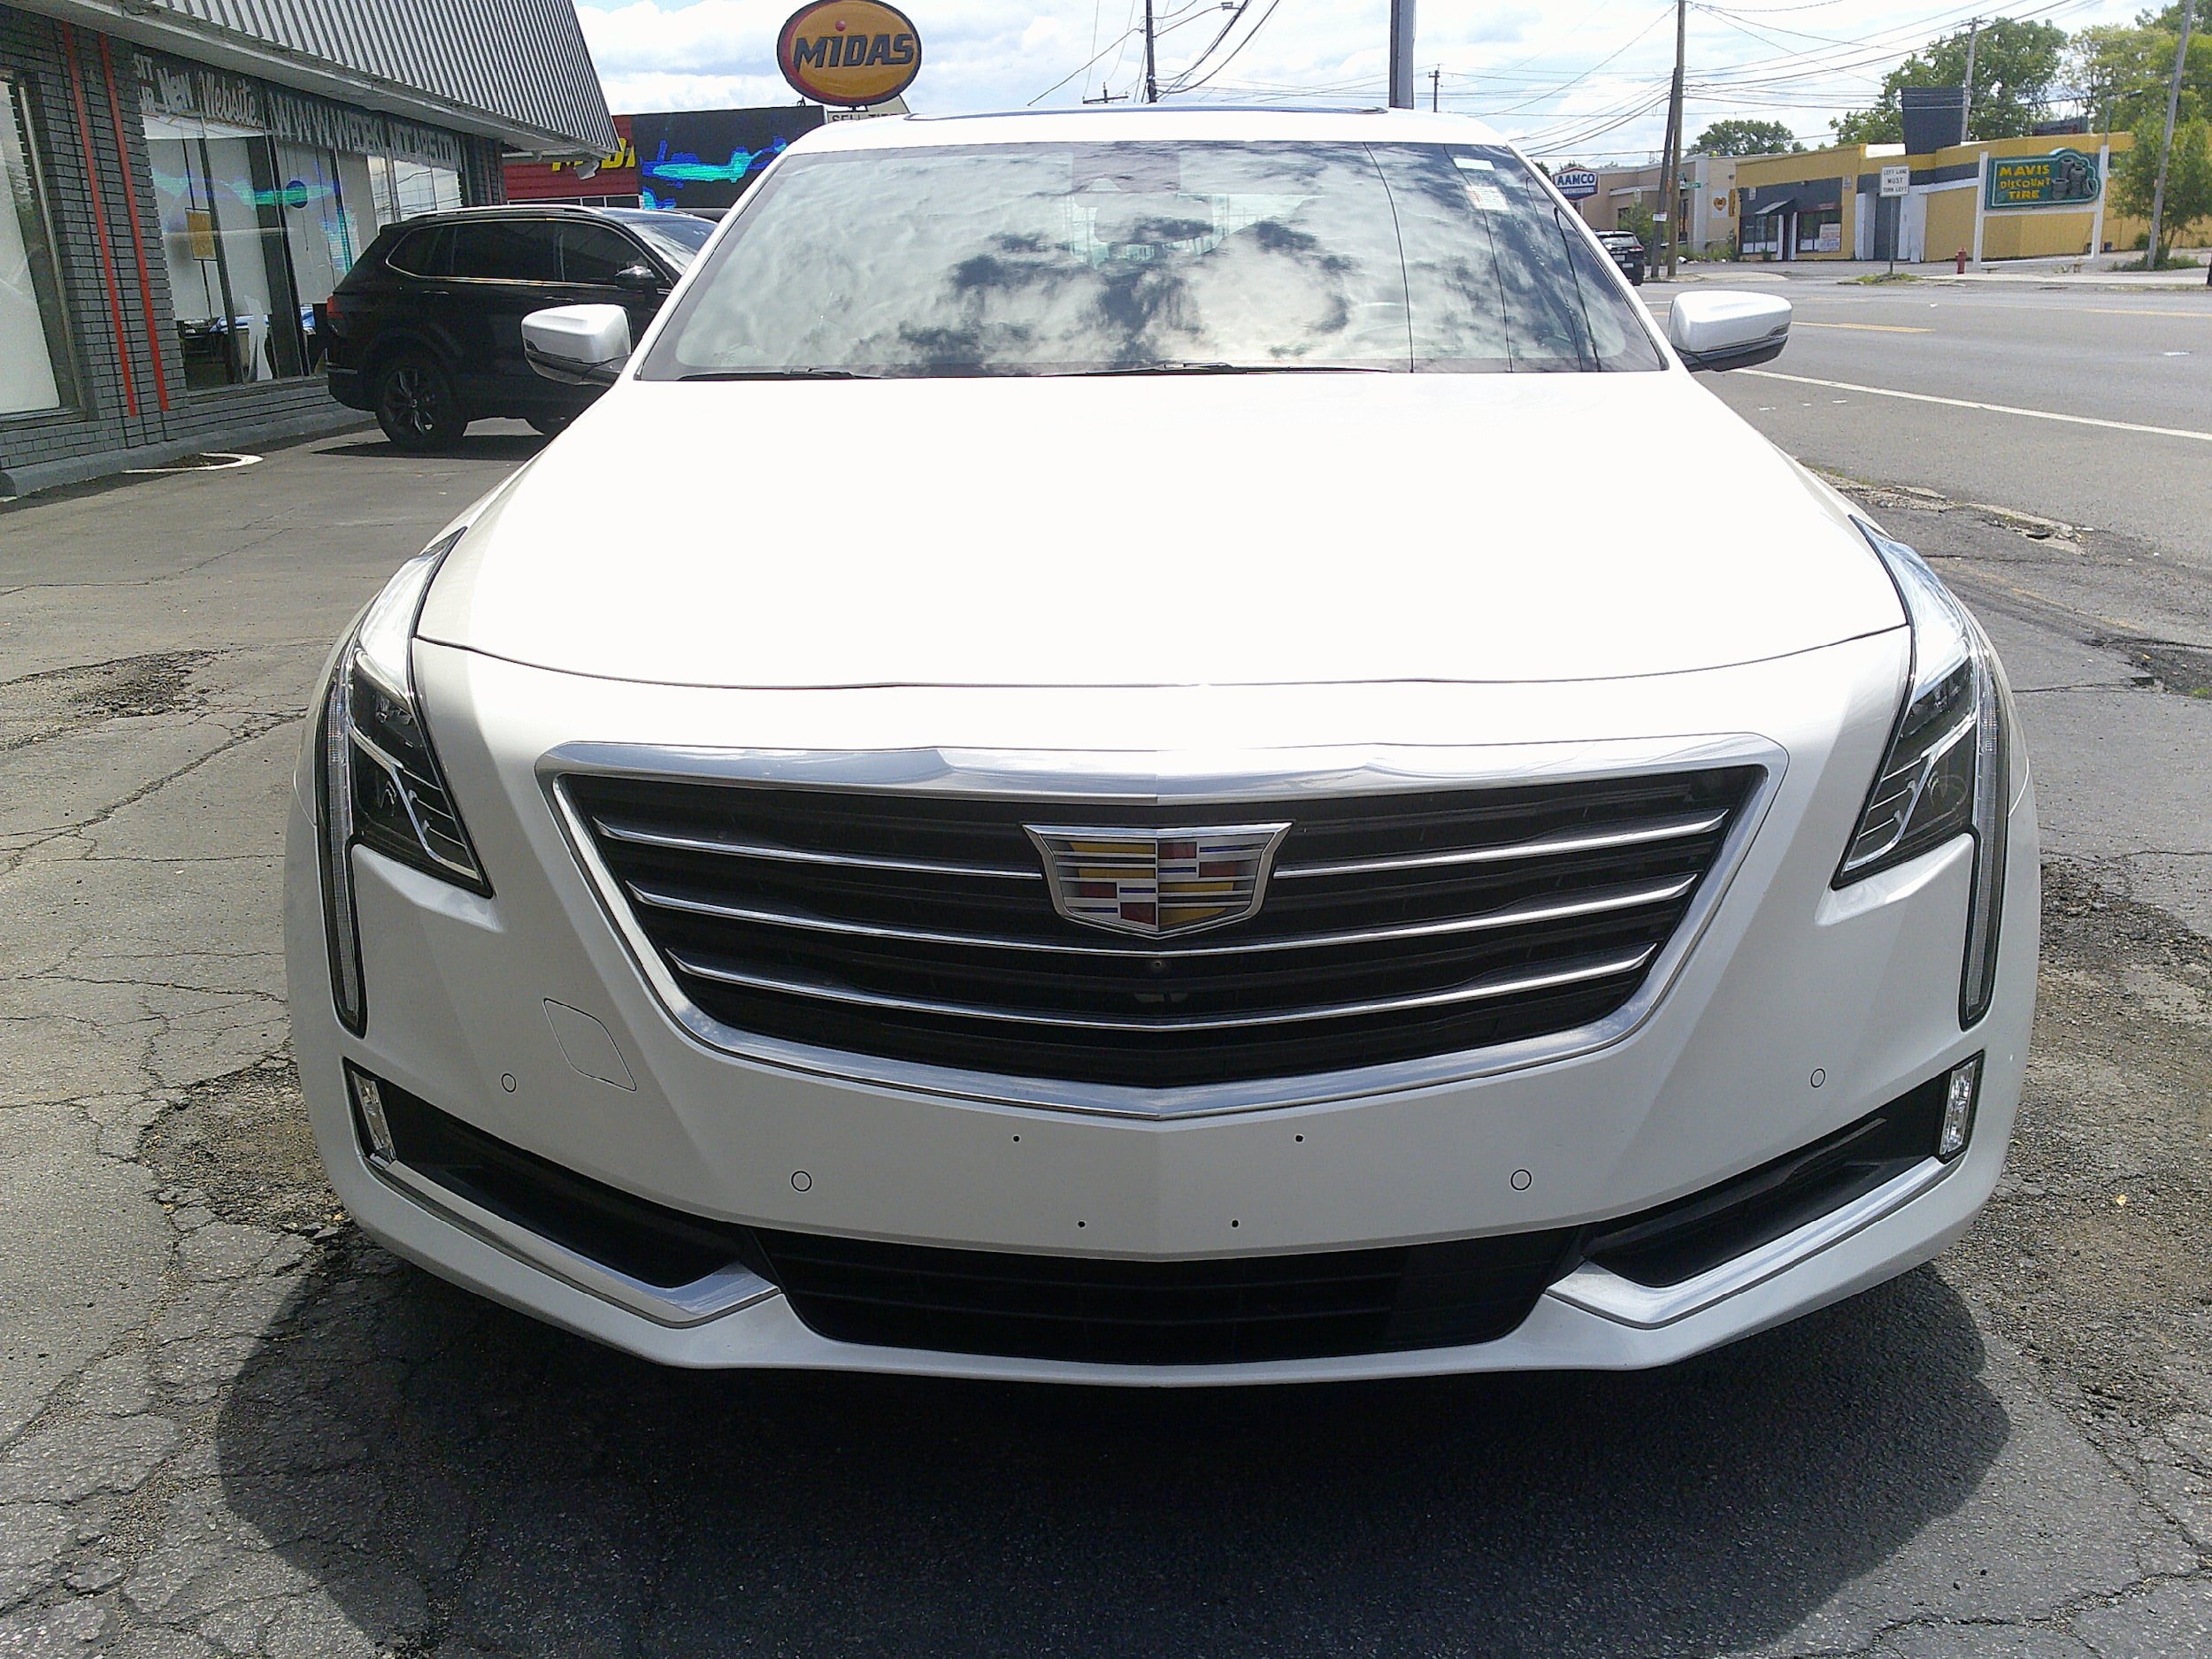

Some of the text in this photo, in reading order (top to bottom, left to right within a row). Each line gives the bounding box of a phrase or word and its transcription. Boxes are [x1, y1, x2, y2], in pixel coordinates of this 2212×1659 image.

[794, 34, 915, 73] MIDAS
[198, 70, 257, 127] Website
[2000, 165, 2050, 176] MAVIS
[1557, 173, 1595, 186] AAMCO
[2000, 177, 2051, 189] DISCOUNT
[2008, 190, 2039, 200] TIRE
